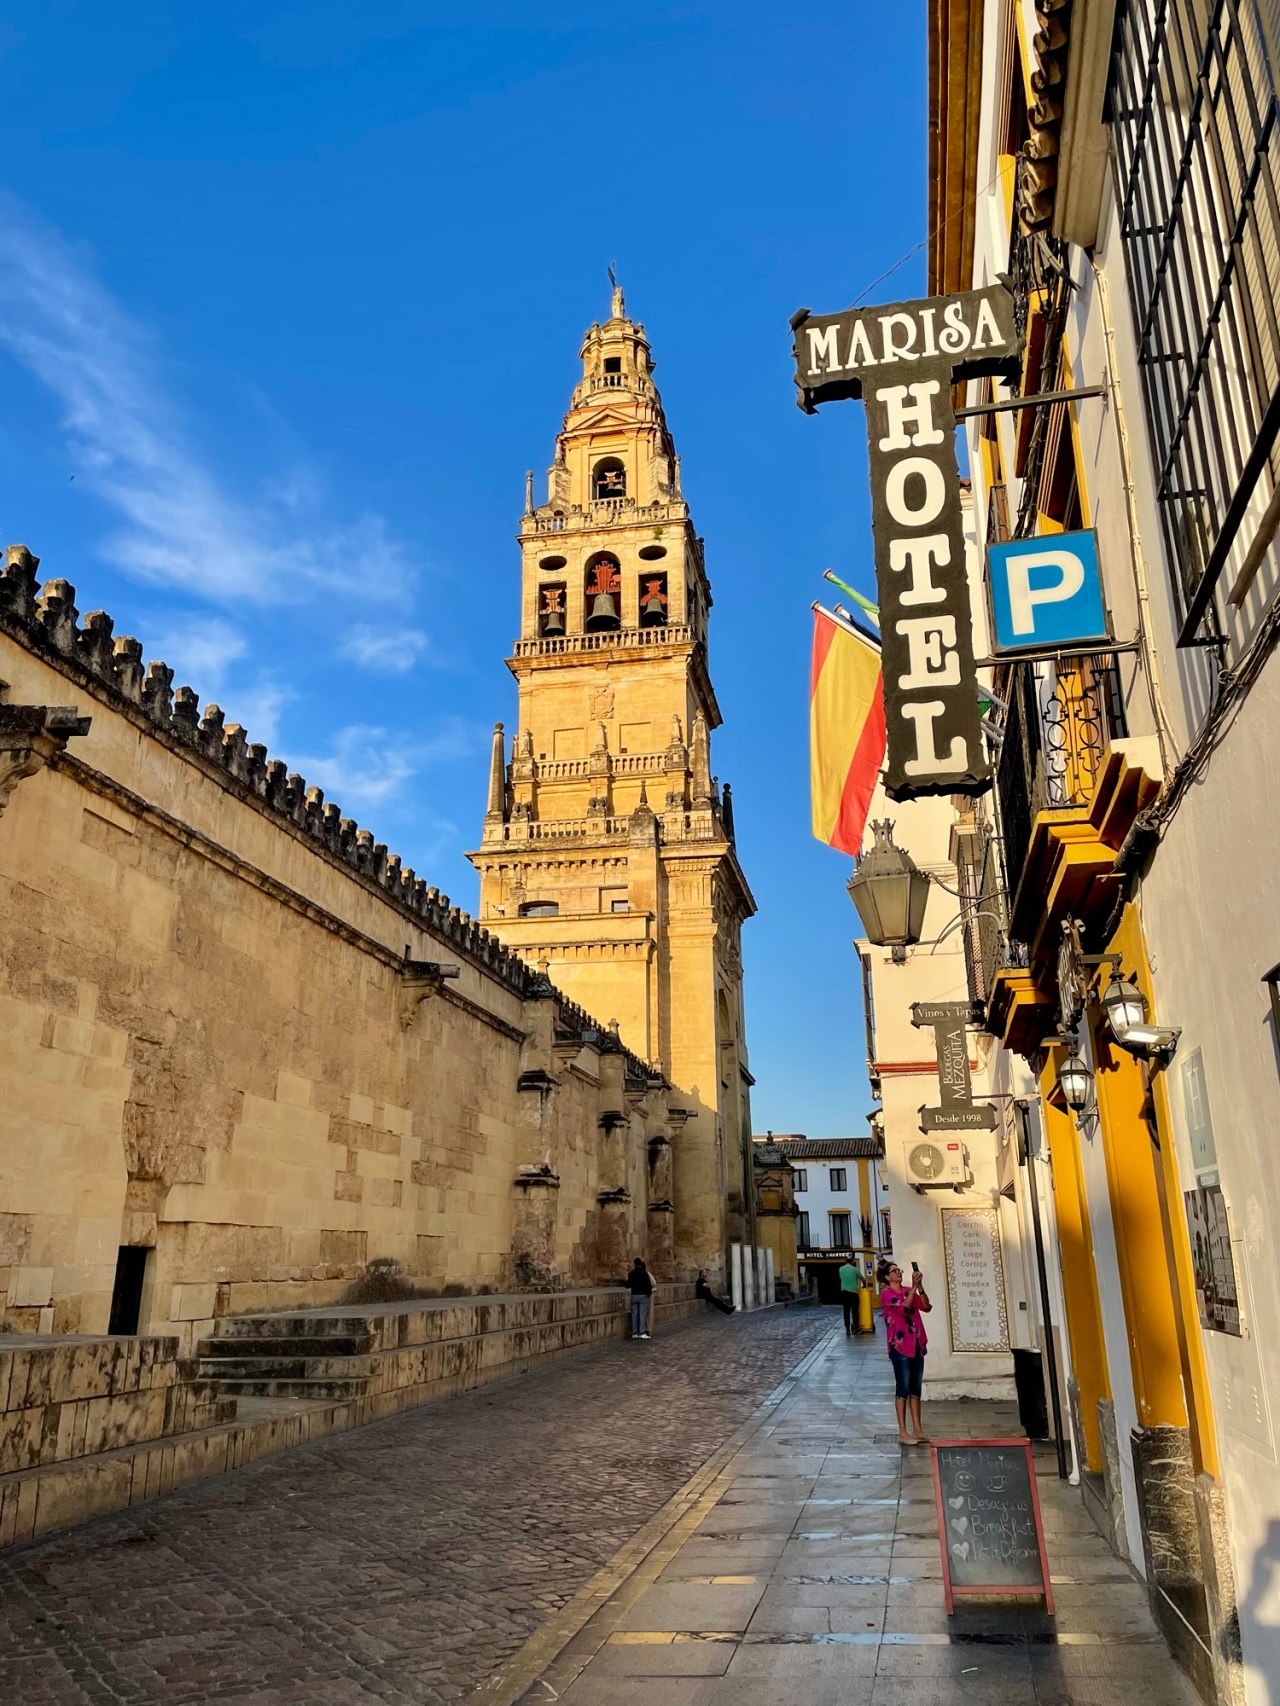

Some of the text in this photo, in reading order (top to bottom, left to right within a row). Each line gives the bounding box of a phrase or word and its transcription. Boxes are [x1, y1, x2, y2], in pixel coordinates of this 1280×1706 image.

[805, 298, 1006, 376] MARISA
[875, 379, 969, 776] HOTEL
[1005, 550, 1085, 636] P
[917, 1006, 982, 1020] Vinos y Tapas
[943, 1046, 953, 1084] BODEGAS
[947, 1030, 967, 1099] MEZQUITA
[935, 1113, 982, 1123] Desde 1998
[963, 1251, 983, 1259] Liège
[961, 1280, 990, 1288] пробка
[967, 1300, 988, 1308] コルク
[971, 1515, 1035, 1545] Breakfast
